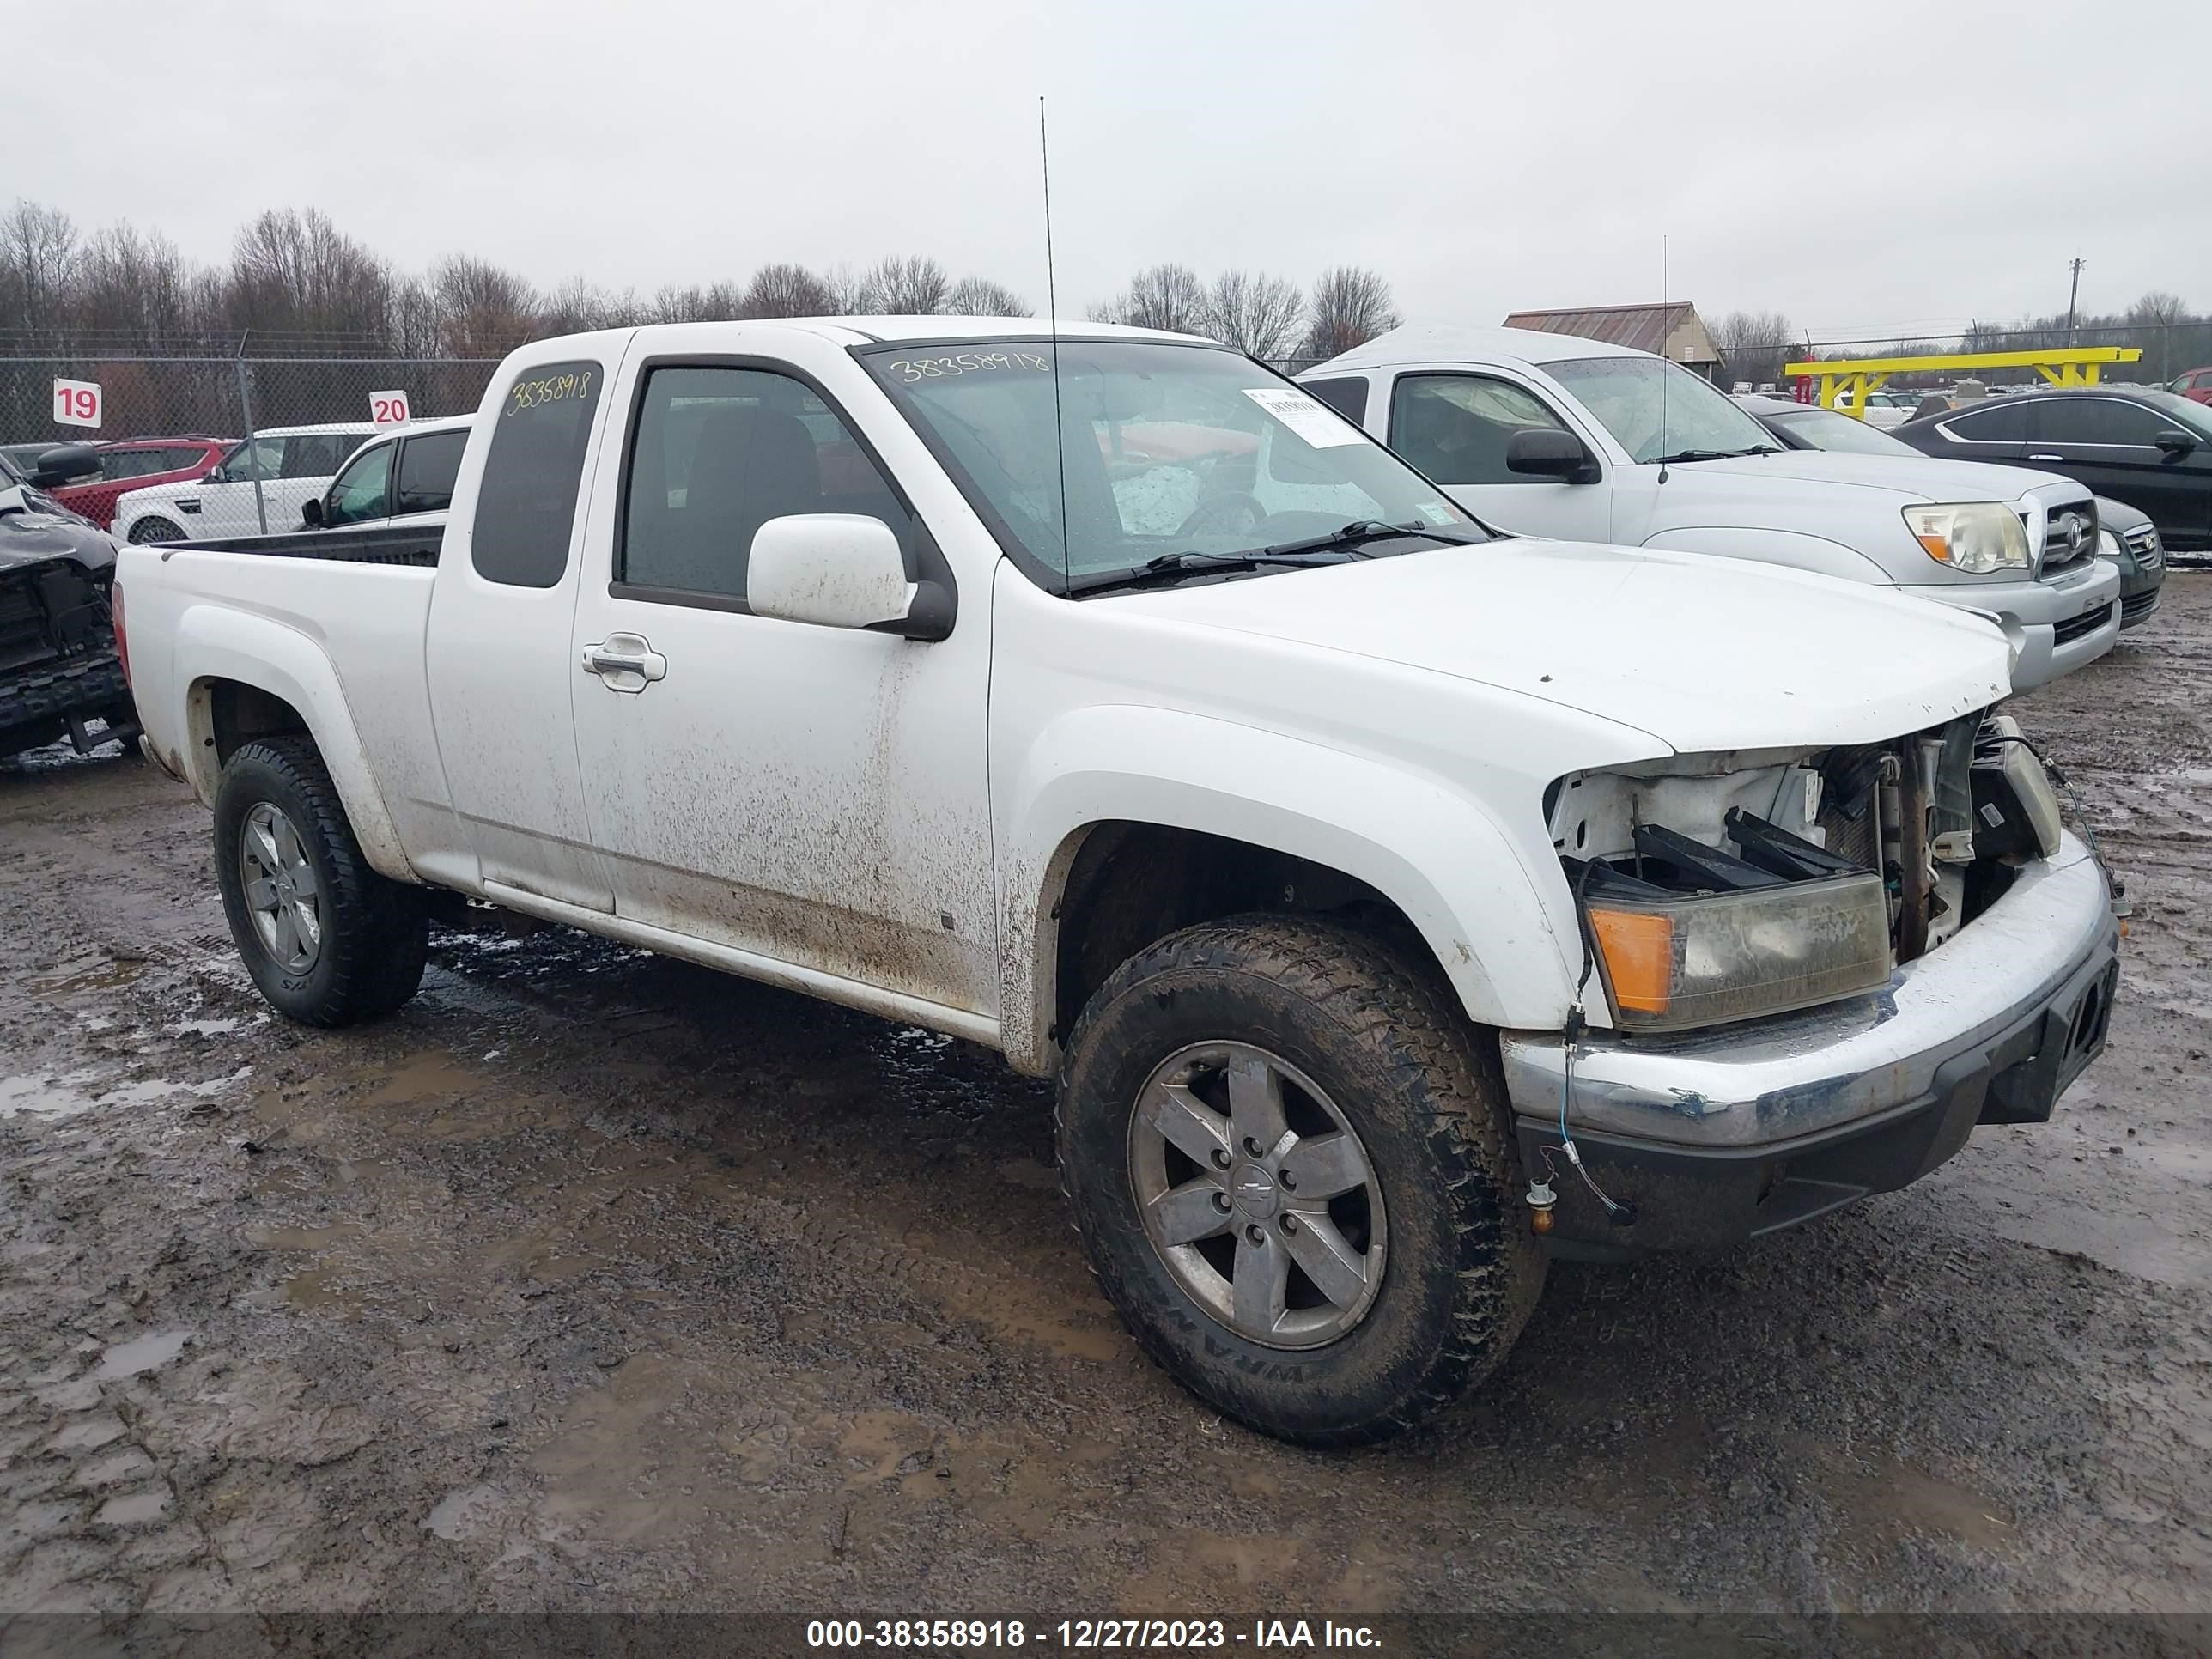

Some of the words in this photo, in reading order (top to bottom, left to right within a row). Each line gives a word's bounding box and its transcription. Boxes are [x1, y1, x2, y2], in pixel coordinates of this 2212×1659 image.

[890, 352, 1050, 383] 38358918
[57, 387, 98, 420] 19
[507, 371, 592, 416] 38358918
[374, 398, 406, 423] 20
